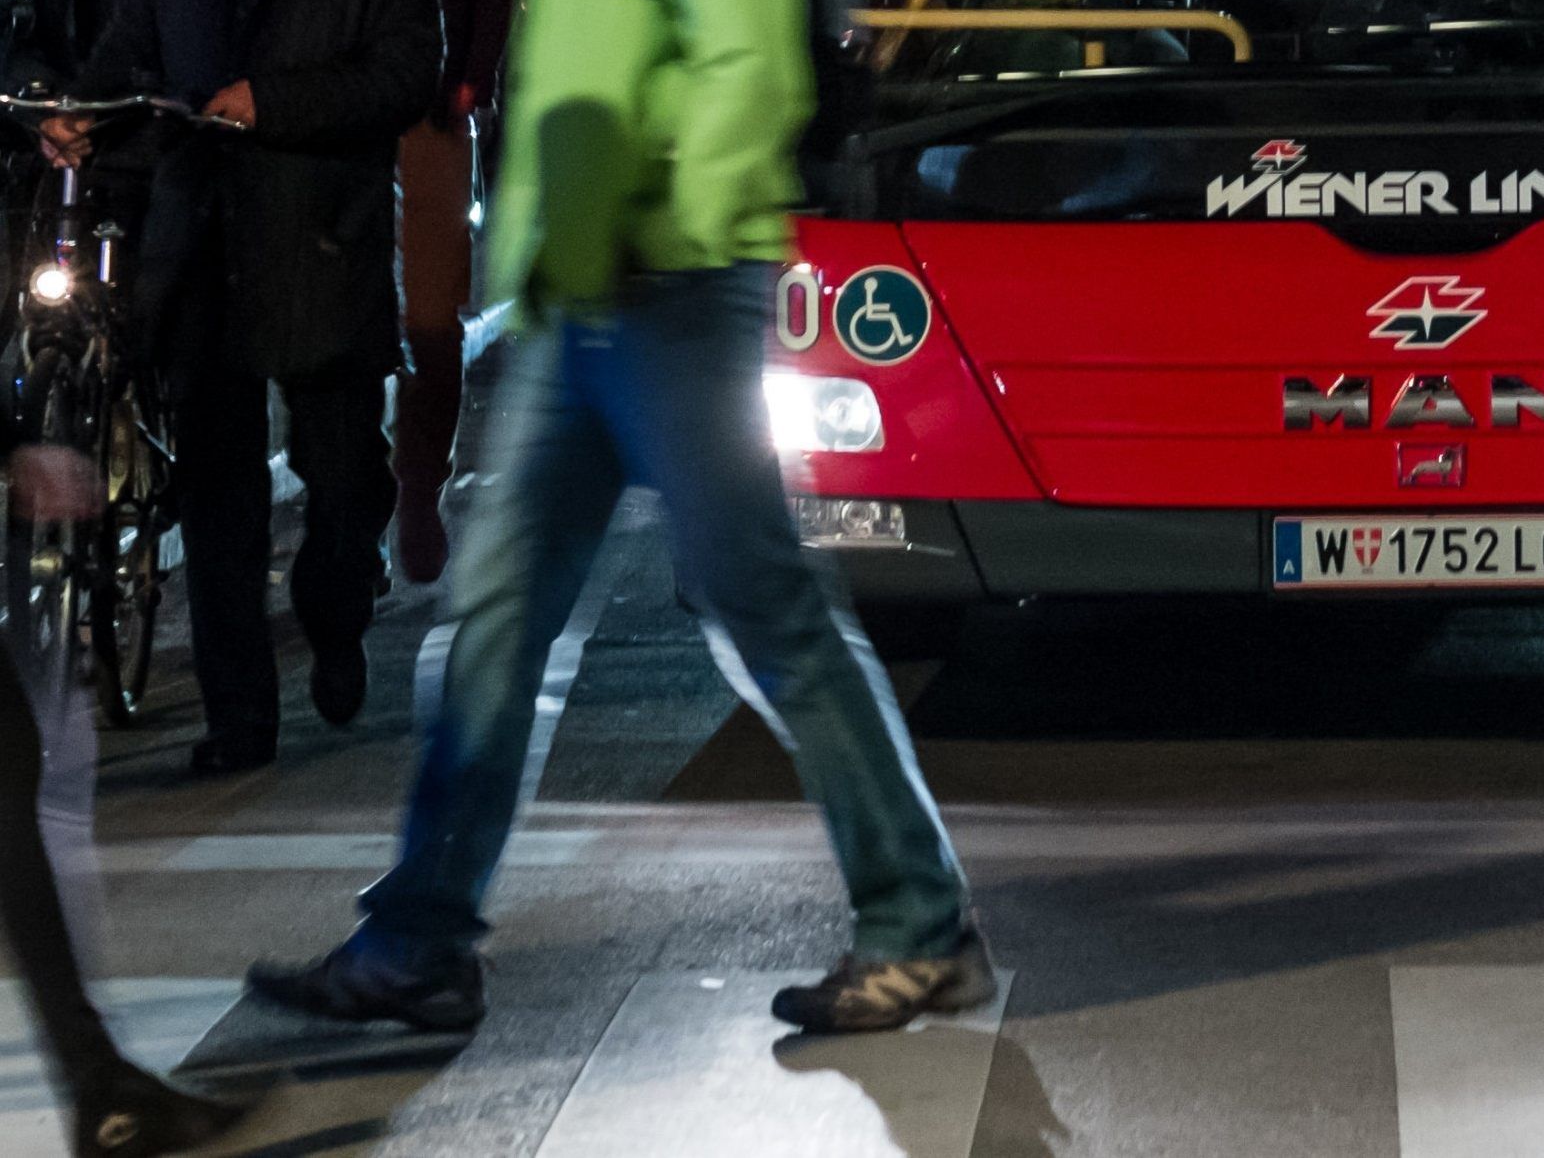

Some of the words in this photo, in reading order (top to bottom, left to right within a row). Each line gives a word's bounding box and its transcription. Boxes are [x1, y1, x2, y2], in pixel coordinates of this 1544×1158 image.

[1207, 170, 1458, 217] WIENER
[1315, 528, 1348, 575] W
[1389, 527, 1499, 575] 1752
